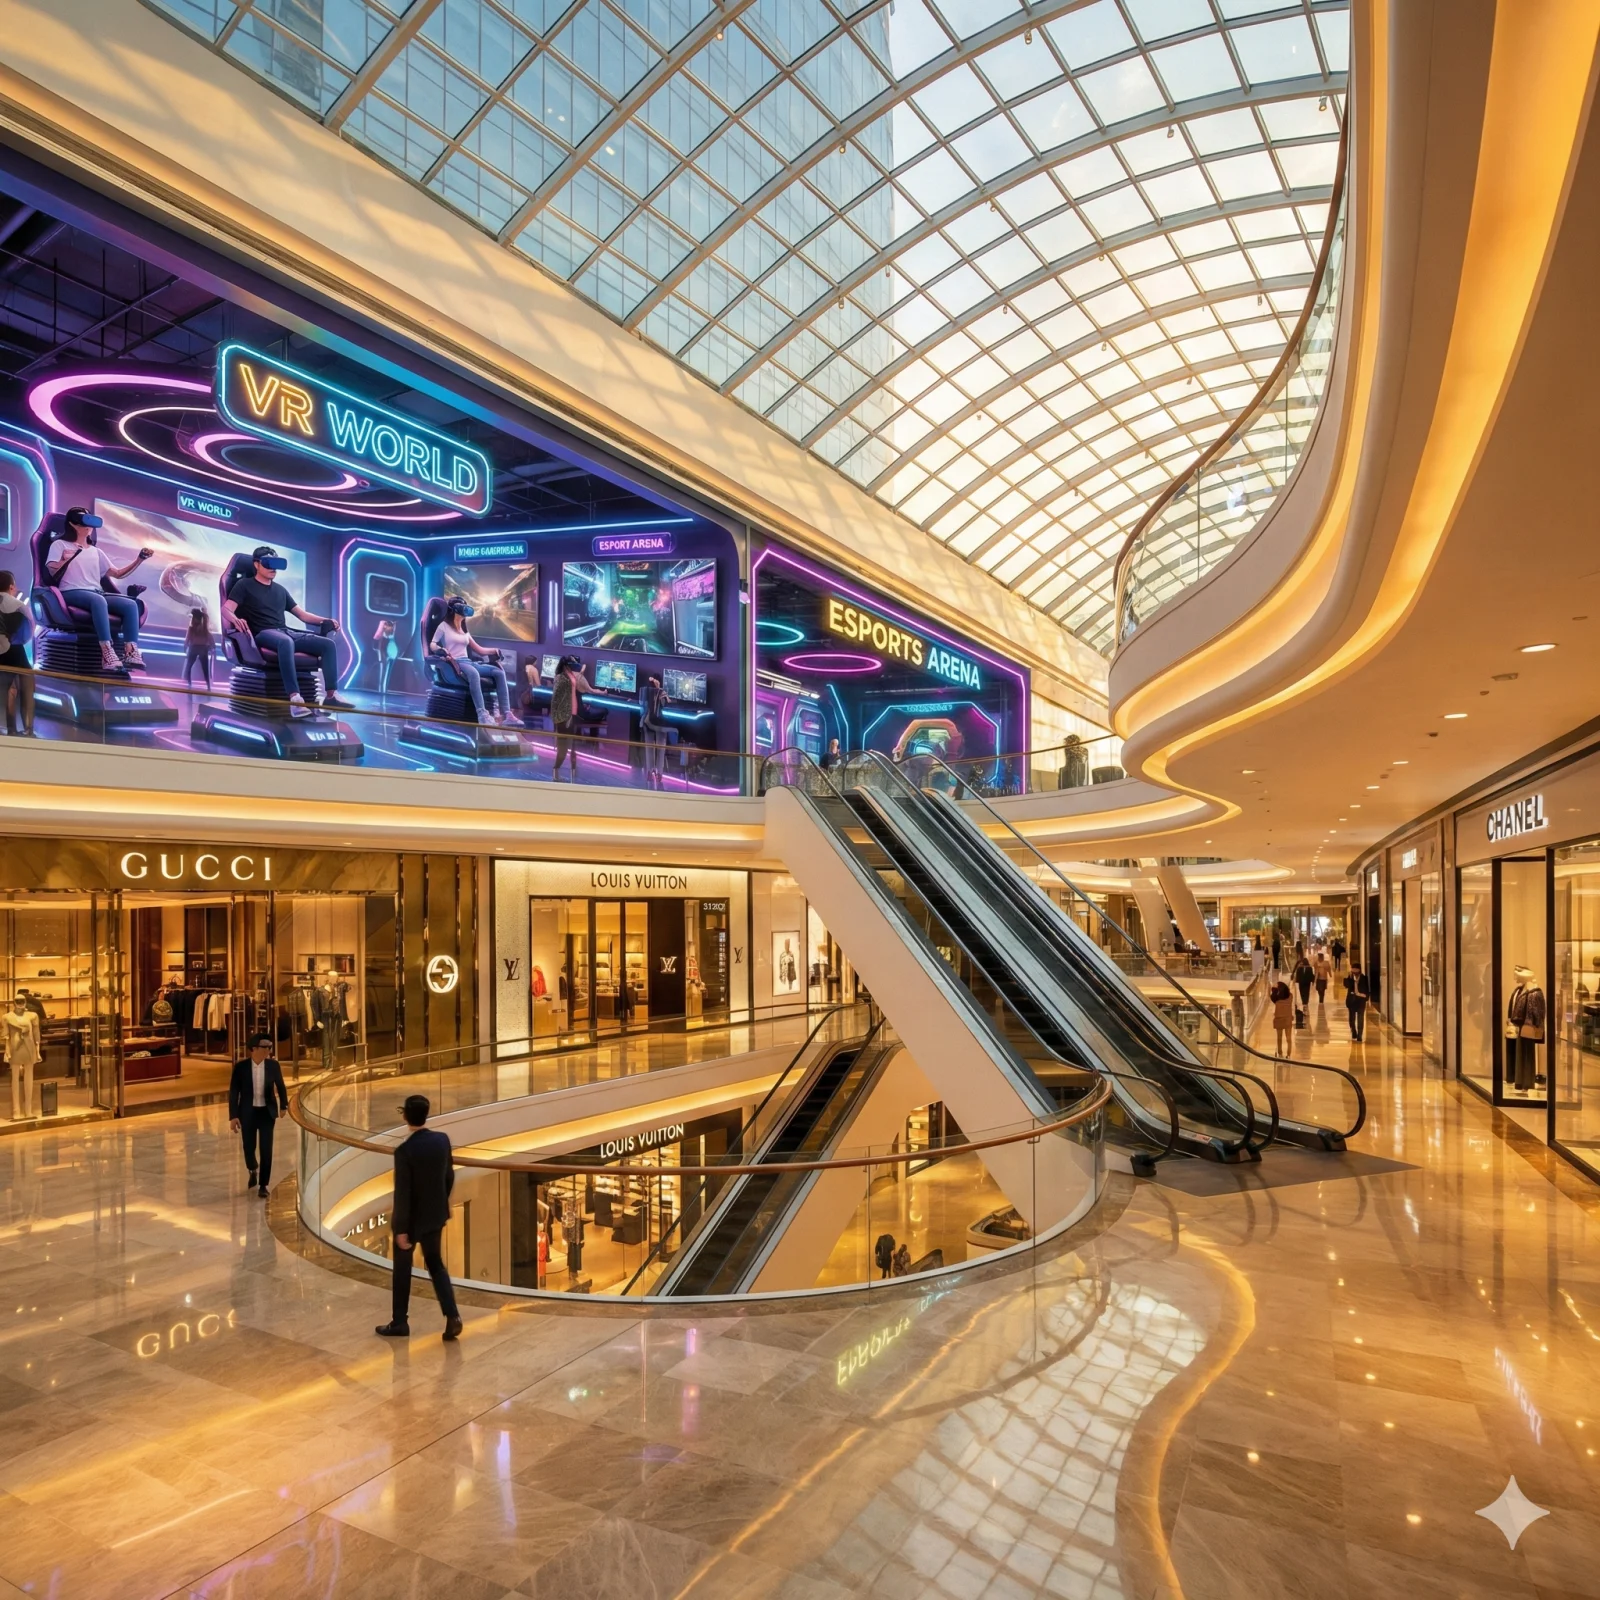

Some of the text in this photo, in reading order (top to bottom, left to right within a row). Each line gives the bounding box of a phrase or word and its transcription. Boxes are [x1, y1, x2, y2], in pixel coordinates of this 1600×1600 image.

[239, 363, 478, 496] VR WORLD
[180, 496, 232, 518] VR WORLD
[599, 538, 664, 551] ESPORT ARENA
[829, 599, 981, 691] ESPORTS ARENA
[1486, 794, 1546, 842] CHANEL
[120, 851, 271, 881] GUCCI
[591, 872, 687, 890] LOUIS VUITTON
[600, 1122, 684, 1159] LOUIS VUITTON
